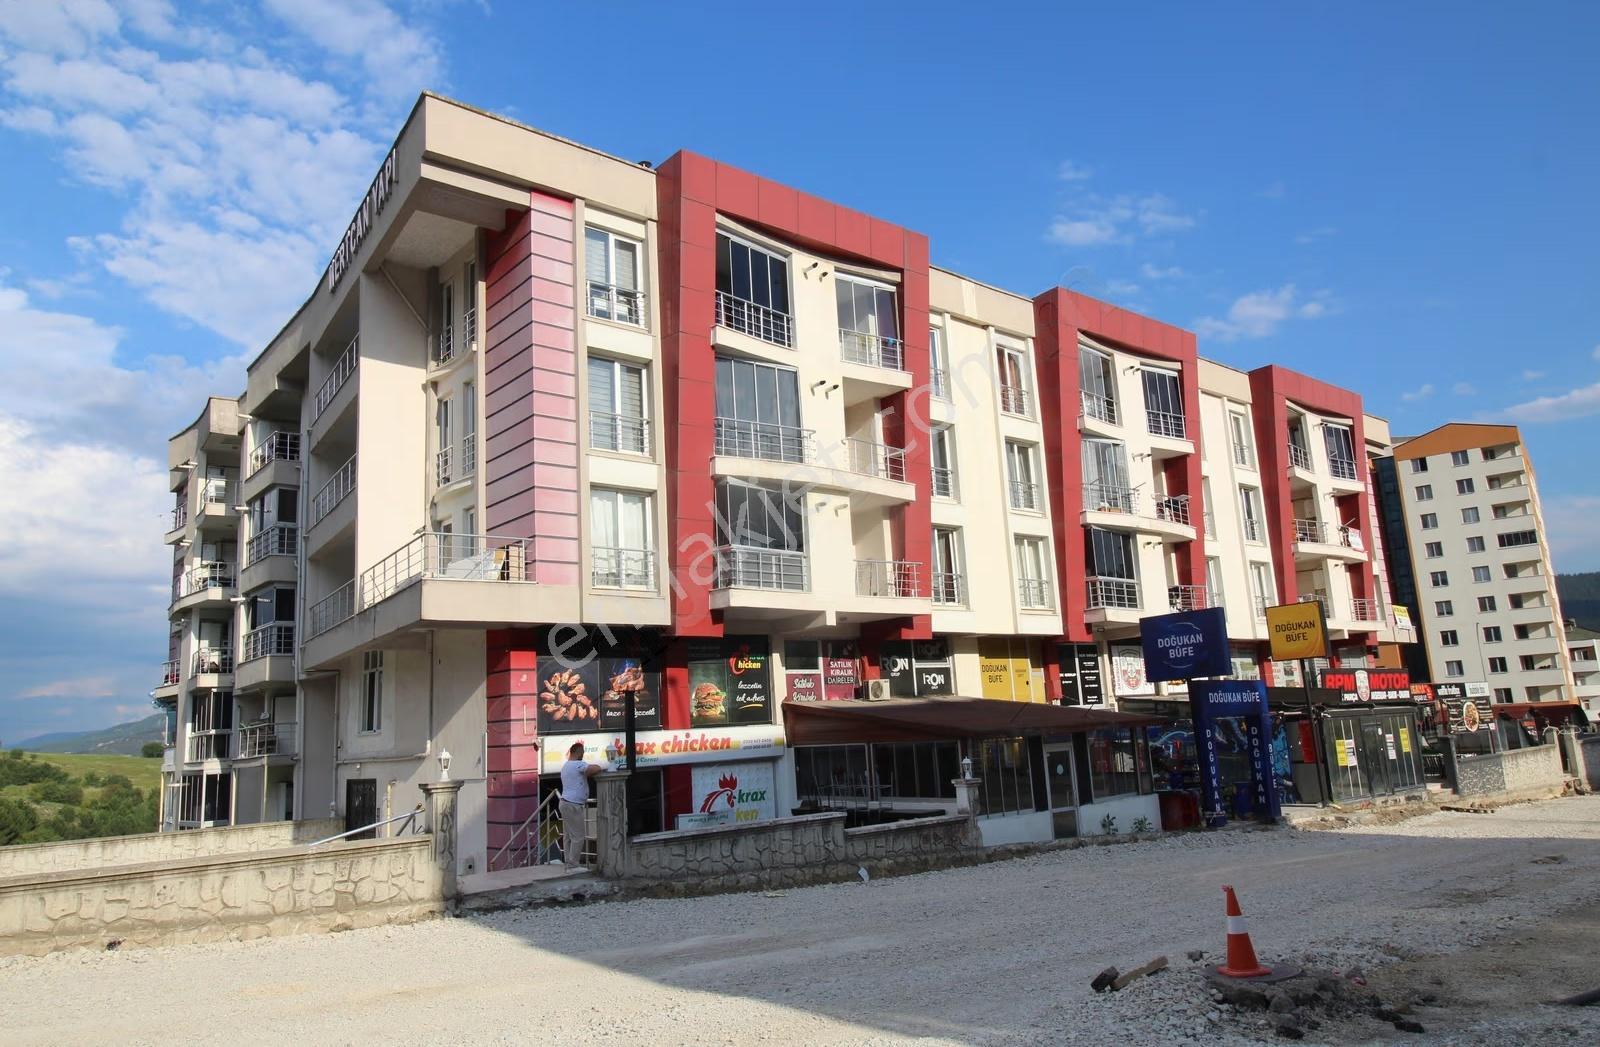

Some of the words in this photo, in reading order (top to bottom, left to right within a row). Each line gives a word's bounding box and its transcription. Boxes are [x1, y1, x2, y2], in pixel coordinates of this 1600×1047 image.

[371, 147, 397, 214] YAPI
[1274, 619, 1316, 633] DOĞUKAN
[1157, 632, 1204, 649] DOĞUKAN
[1285, 631, 1309, 643] BÜFE
[1168, 646, 1195, 659] BÜFE
[1325, 673, 1355, 692] RPM
[1369, 673, 1409, 690] MOTOR
[1208, 690, 1243, 704] DOĞUKAN
[1243, 689, 1260, 703] BÜFE
[660, 731, 732, 754] chicken
[737, 788, 767, 803] krax
